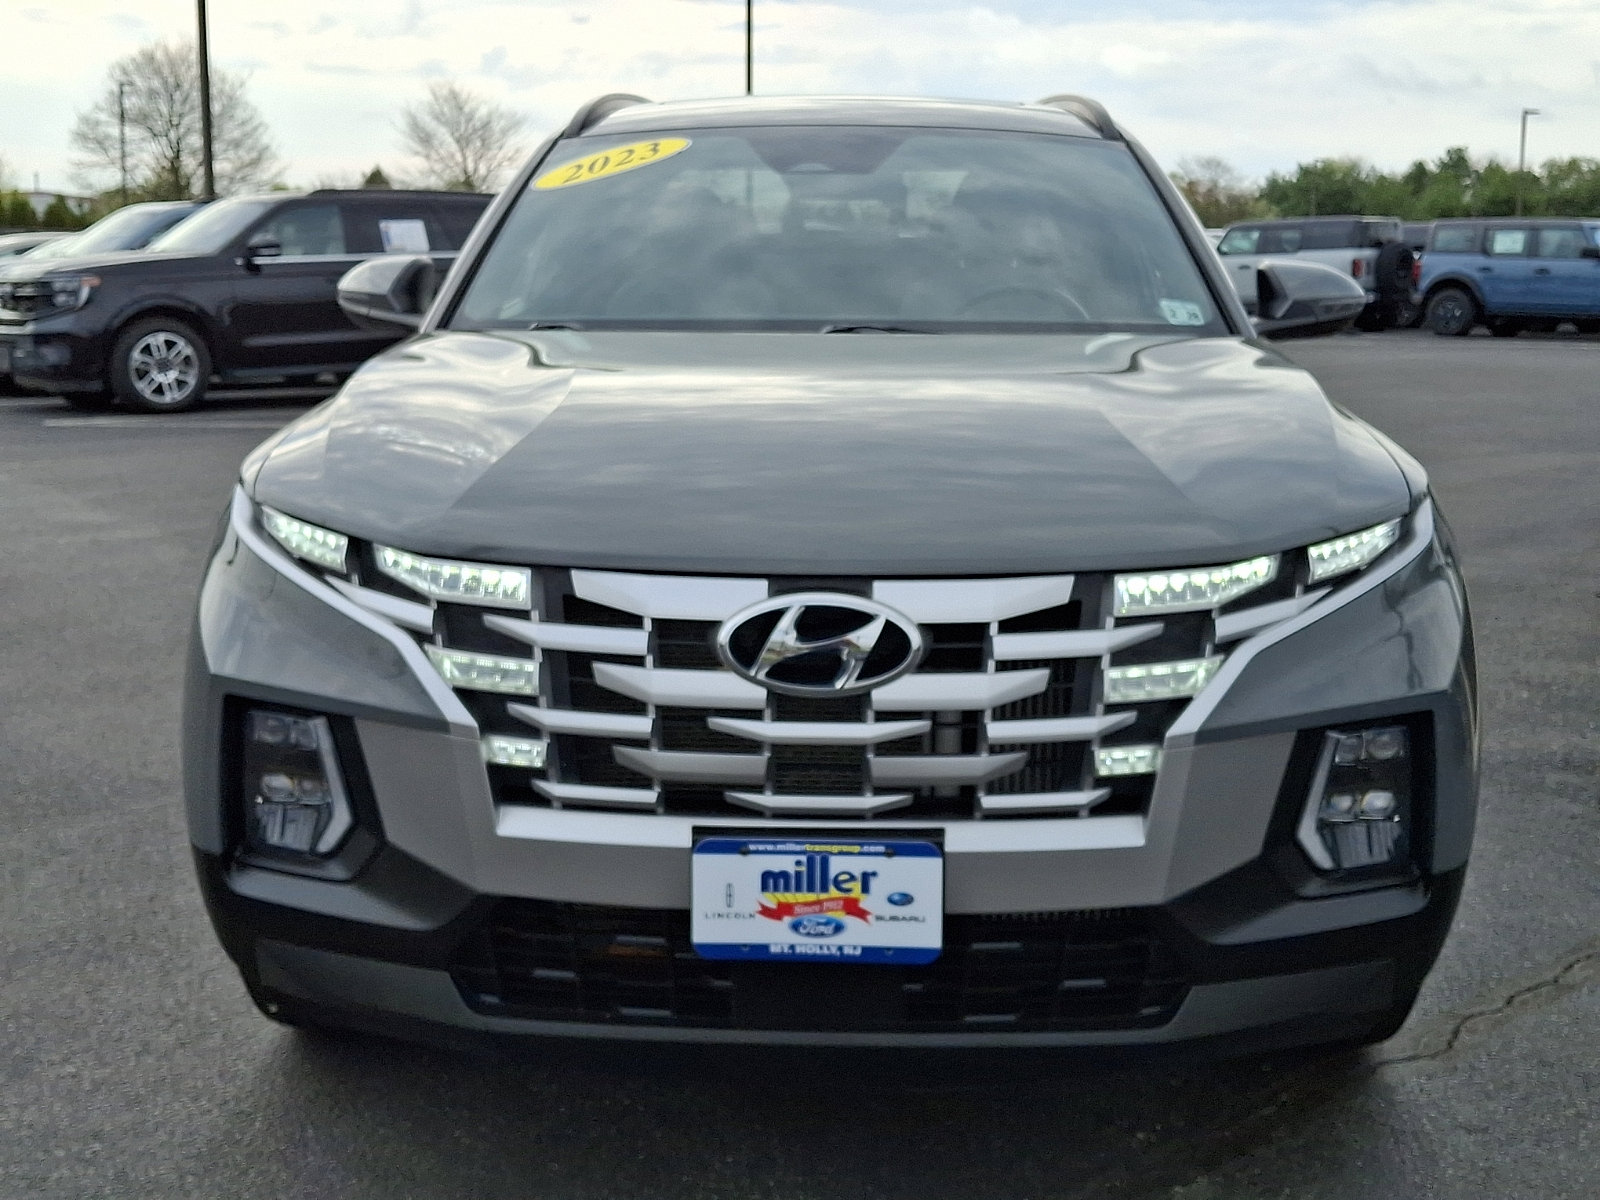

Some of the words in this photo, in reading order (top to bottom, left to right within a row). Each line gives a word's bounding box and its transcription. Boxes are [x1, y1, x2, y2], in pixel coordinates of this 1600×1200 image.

[563, 143, 661, 184] 2023
[761, 854, 878, 894] miller
[705, 912, 756, 920] LINCOLN
[799, 918, 836, 935] Ford
[795, 944, 840, 956] HOLLY,
[842, 945, 862, 955] NJ
